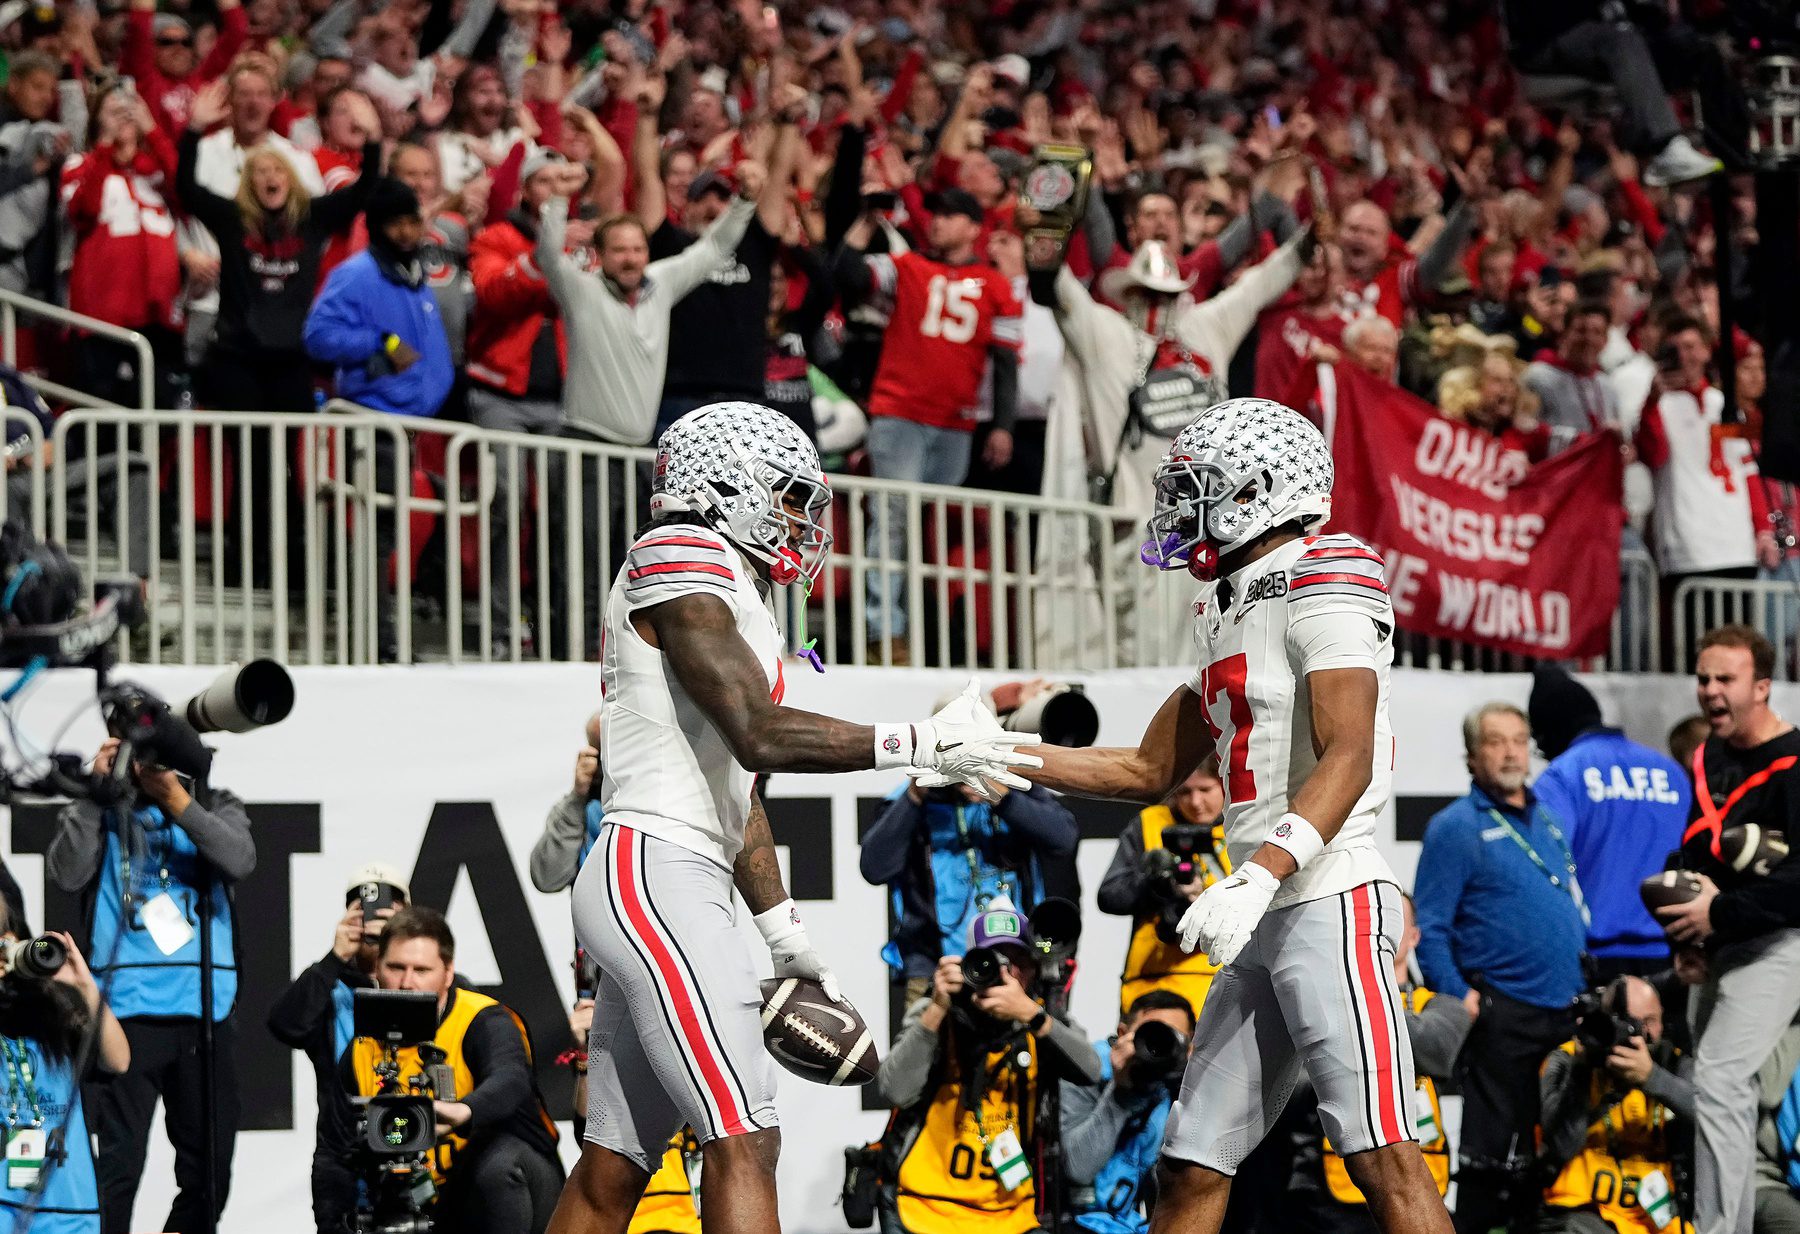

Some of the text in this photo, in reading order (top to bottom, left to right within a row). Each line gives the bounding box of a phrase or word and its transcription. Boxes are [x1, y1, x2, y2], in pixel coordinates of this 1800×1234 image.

[920, 273, 982, 343] 15
[1244, 570, 1288, 605] 2025
[1436, 569, 1571, 648] WORLD
[1583, 765, 1679, 804] S.A.F.E.
